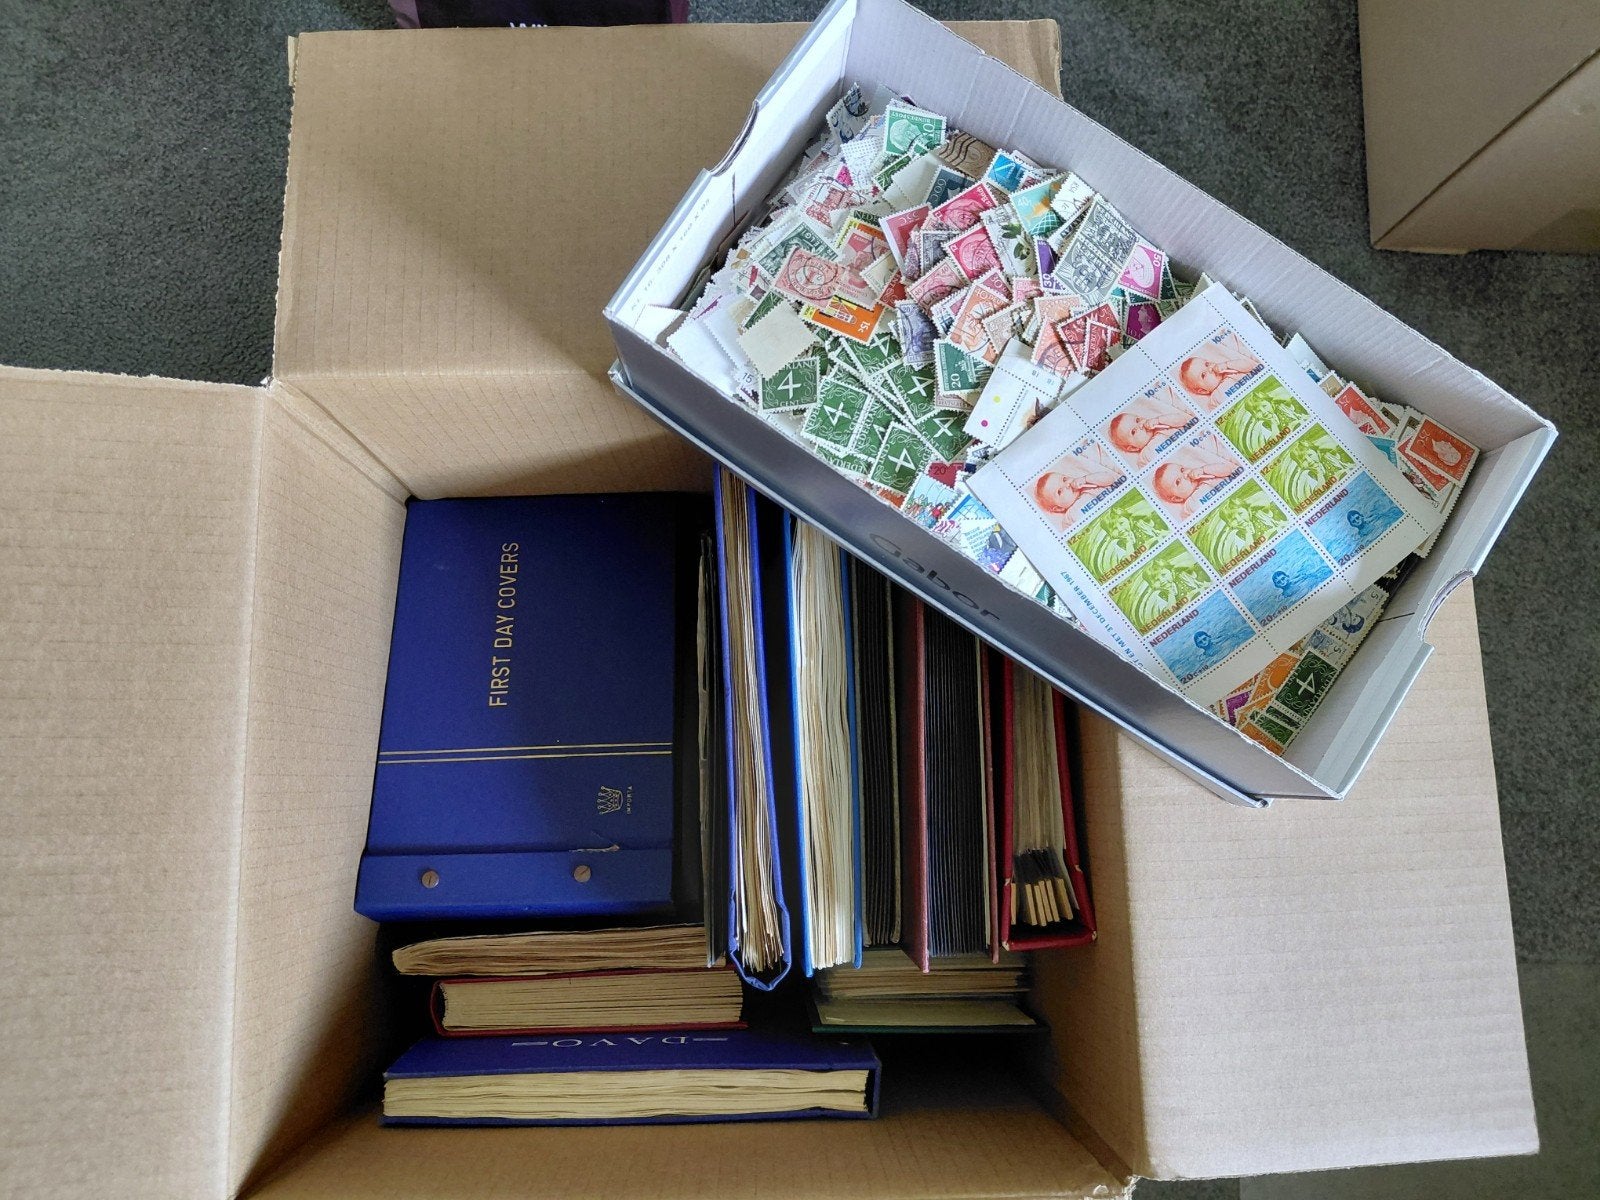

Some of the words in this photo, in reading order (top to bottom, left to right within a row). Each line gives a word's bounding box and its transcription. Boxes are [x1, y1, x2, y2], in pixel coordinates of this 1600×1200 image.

[1153, 253, 1162, 268] 50
[1043, 273, 1053, 288] 30
[742, 372, 754, 384] 15
[777, 370, 801, 400] 4
[907, 375, 934, 396] 4
[950, 373, 961, 389] 20
[1225, 363, 1265, 398] NEDERLAND
[823, 402, 851, 426] 4
[933, 417, 957, 437] 4
[1155, 417, 1199, 454] NEDERLAND
[1250, 427, 1291, 463] NEDERLAND
[887, 448, 916, 473] 4
[933, 465, 947, 475] 20
[1081, 475, 1127, 515] NEDERLAND
[1200, 466, 1244, 505] NEDERLAND
[1294, 476, 1337, 514] NEDERLAND
[1305, 487, 1349, 527] NEDERLAND
[1100, 544, 1147, 584] NEDERLAND
[1219, 535, 1266, 575] NEDERLAND
[1228, 548, 1277, 588] NEDERLAND
[497, 541, 519, 609] COVERS
[870, 533, 1000, 620] Gabor
[1060, 571, 1075, 585] 1967
[1074, 585, 1106, 624] DECEMBER
[1141, 596, 1190, 635] NEDERLAND
[494, 614, 515, 648] DAY
[1104, 624, 1114, 632] 31
[1111, 632, 1126, 648] MET
[1149, 609, 1199, 647] NEDERLAND
[489, 656, 511, 707] FIRST
[1296, 673, 1316, 696] 4
[553, 1037, 687, 1047] DAVO
